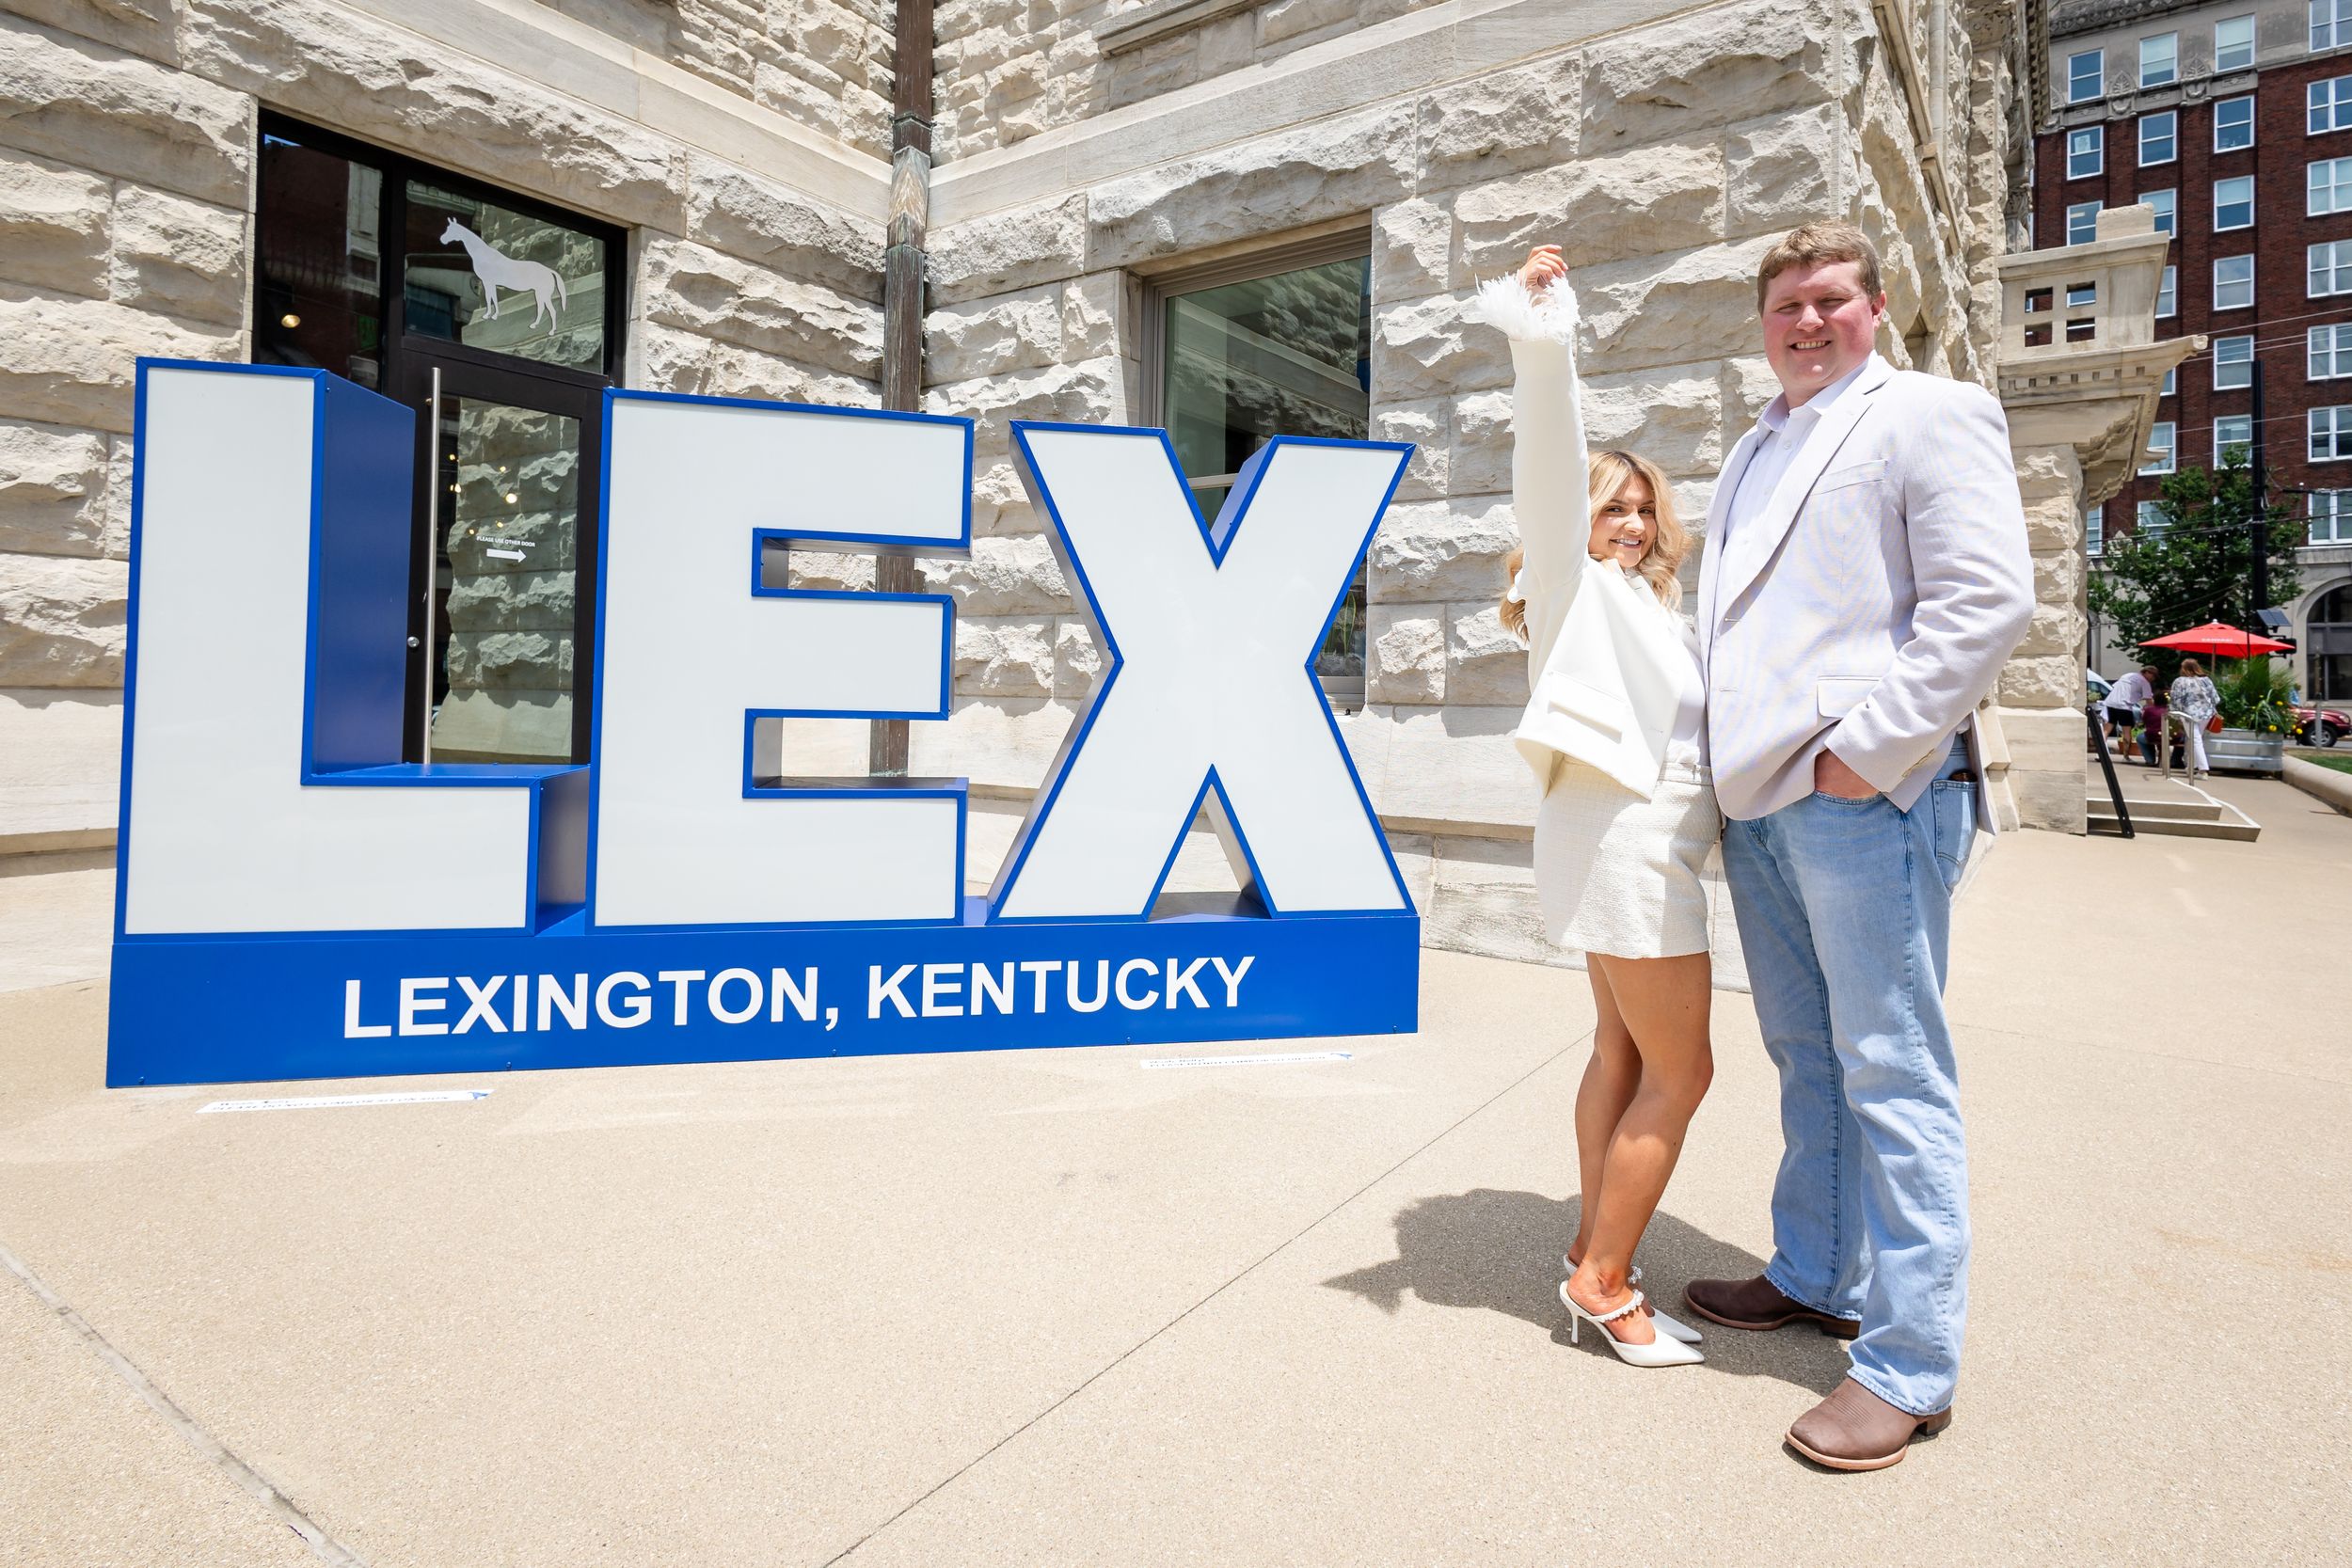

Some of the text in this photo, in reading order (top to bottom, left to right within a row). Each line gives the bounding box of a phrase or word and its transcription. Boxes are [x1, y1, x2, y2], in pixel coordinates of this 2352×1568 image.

[119, 356, 1415, 936] LEX
[343, 956, 1255, 1038] LEXINGTON, KENTUCKY
